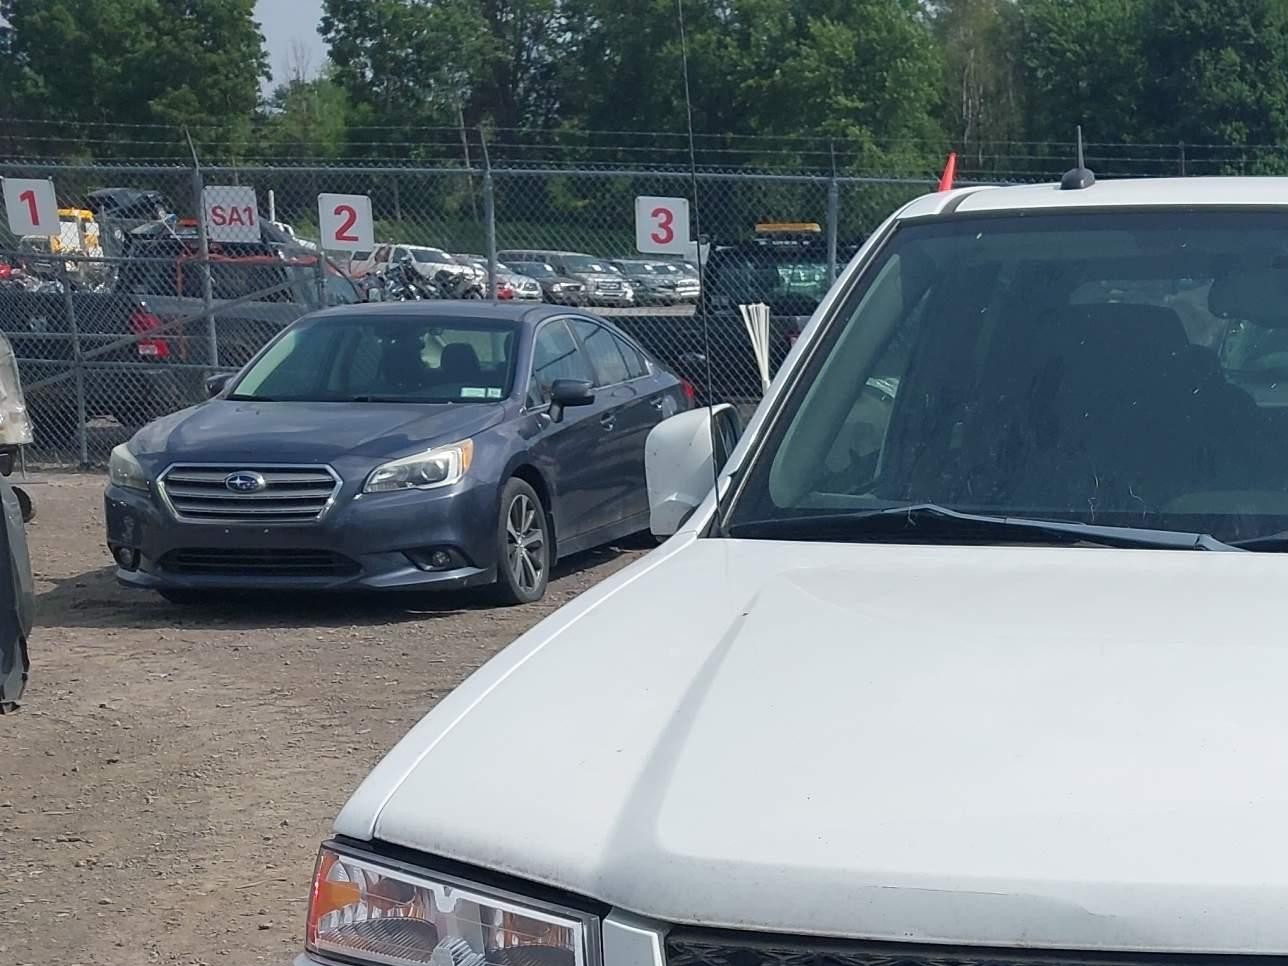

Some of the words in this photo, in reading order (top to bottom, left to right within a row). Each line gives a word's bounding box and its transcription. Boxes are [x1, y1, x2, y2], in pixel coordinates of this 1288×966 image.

[19, 190, 40, 226] 1
[211, 205, 255, 226] SA1
[333, 205, 359, 242] 2
[650, 207, 674, 244] 3
